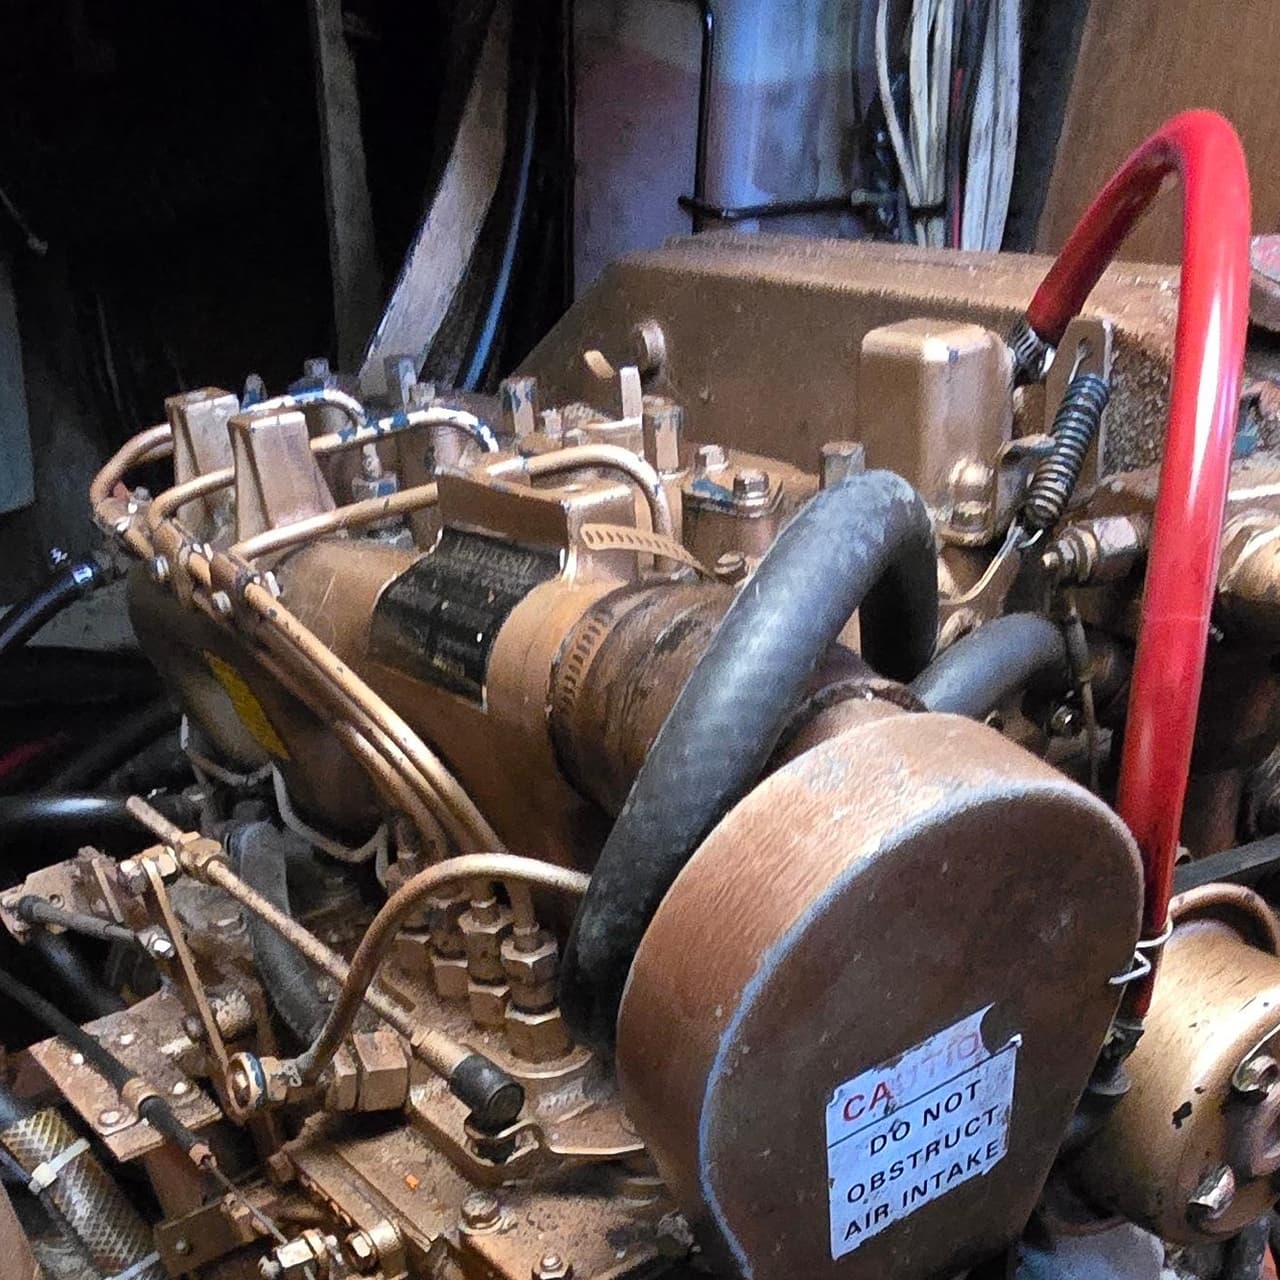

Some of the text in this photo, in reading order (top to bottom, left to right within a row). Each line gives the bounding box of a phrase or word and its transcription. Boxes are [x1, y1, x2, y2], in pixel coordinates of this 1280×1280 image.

[846, 1104, 1000, 1204] OBSTRUCT
[869, 1079, 982, 1157] DO NOT
[843, 1138, 1000, 1242] AIR INTAKE
